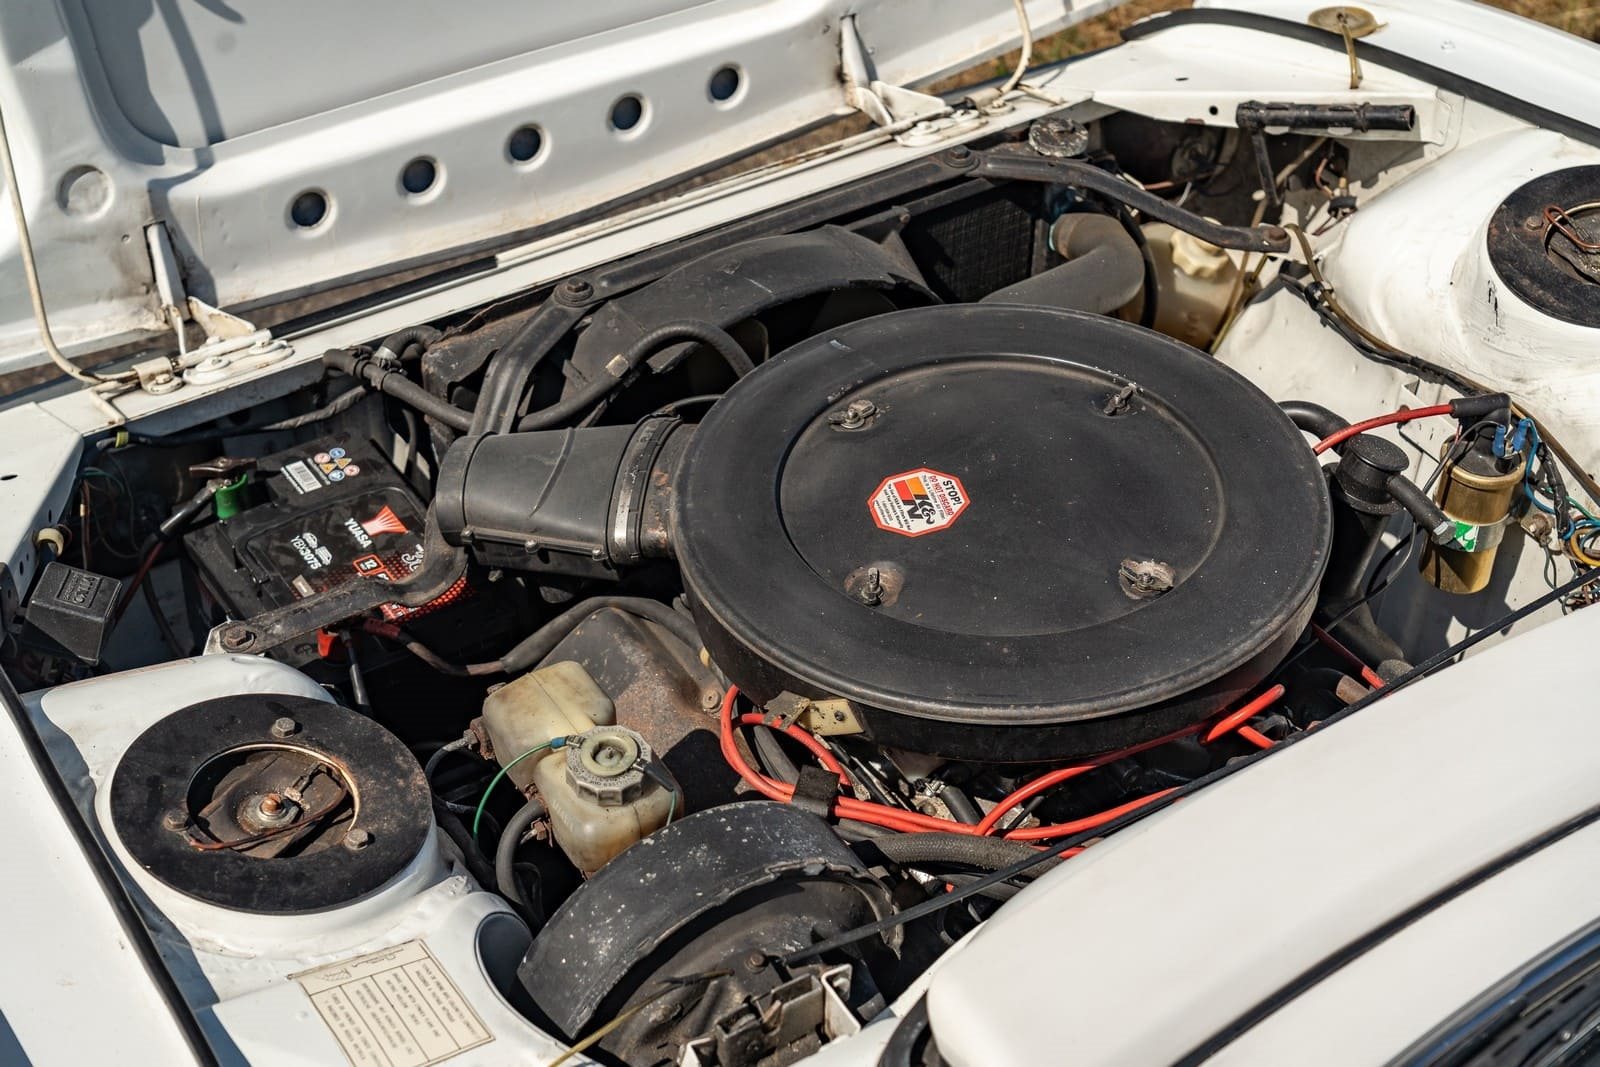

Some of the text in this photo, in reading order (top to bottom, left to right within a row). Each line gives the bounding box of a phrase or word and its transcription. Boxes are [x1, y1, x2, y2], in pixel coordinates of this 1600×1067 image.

[930, 475, 954, 516] DO NOT DISCARD
[943, 480, 962, 505] STOP!
[344, 518, 372, 548] YUASA
[290, 536, 321, 570] YBX3075
[364, 559, 377, 570] 12
